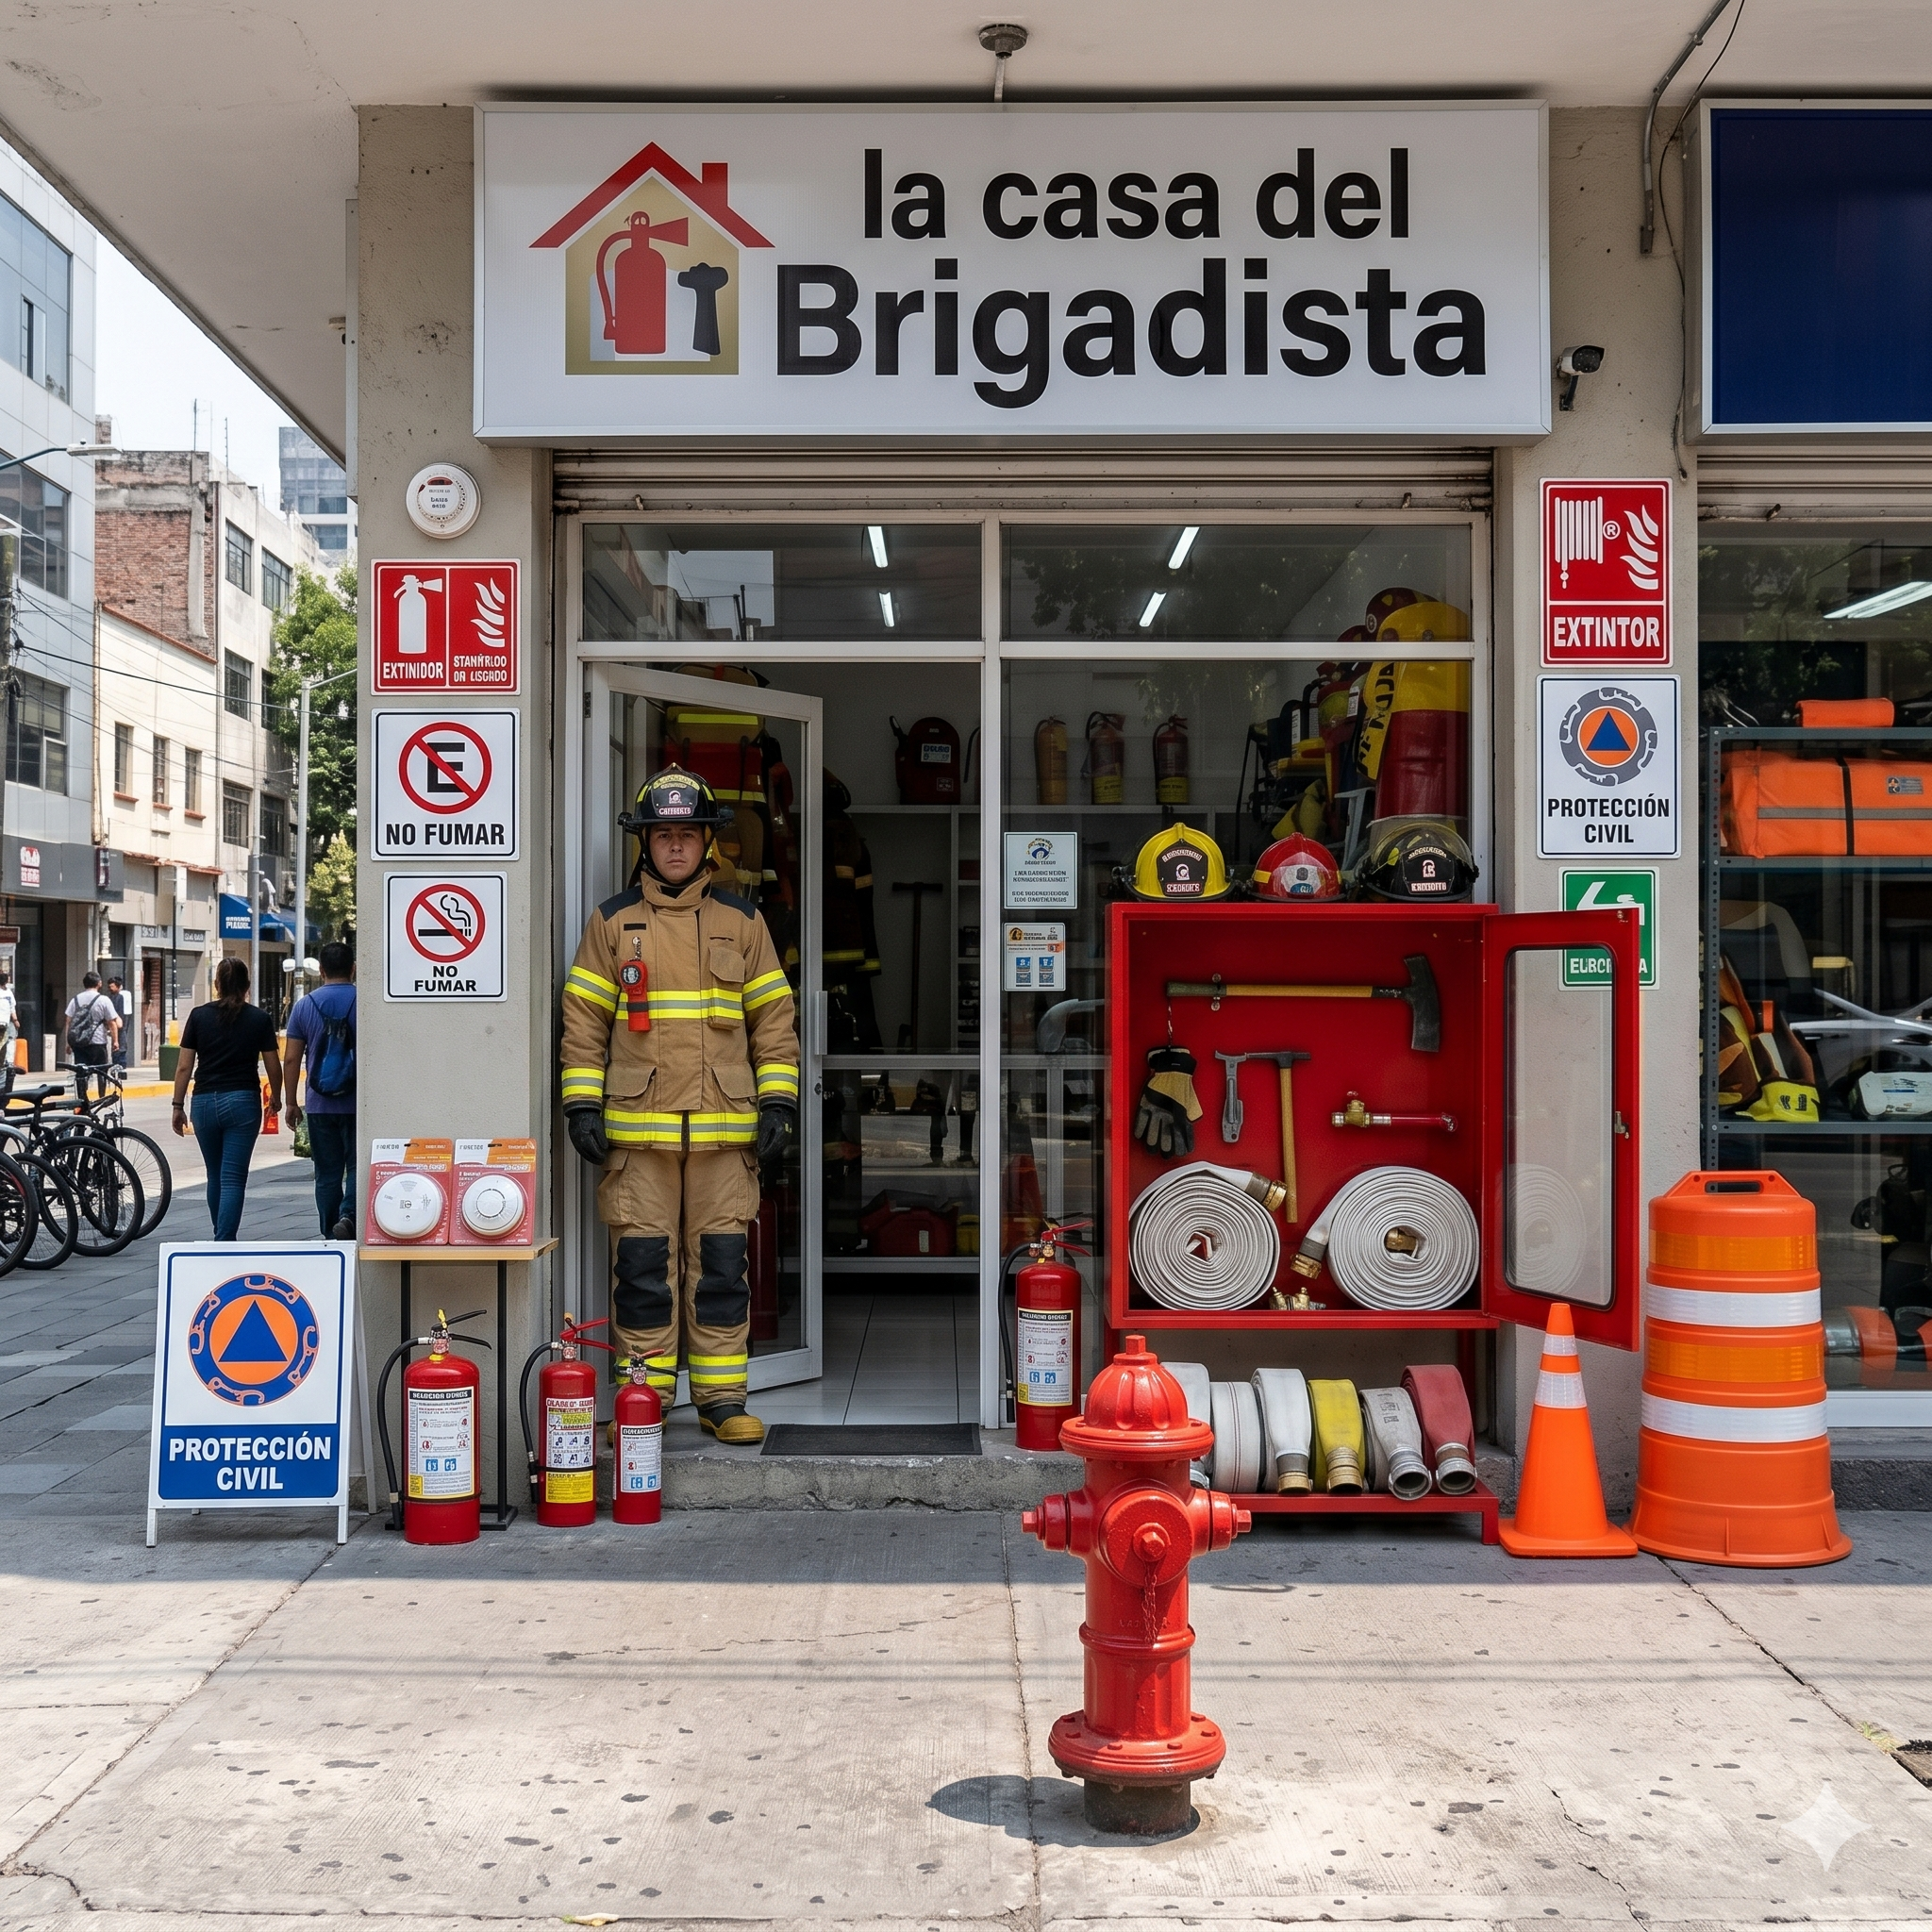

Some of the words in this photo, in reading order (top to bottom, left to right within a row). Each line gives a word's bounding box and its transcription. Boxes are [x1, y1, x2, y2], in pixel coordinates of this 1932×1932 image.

[864, 148, 947, 241] la
[982, 172, 1221, 241] casa
[1256, 147, 1409, 240] del
[776, 257, 1487, 409] Brigadista
[1554, 616, 1660, 648] EXTINTOR
[383, 661, 444, 679] EXTINIDOR
[1547, 792, 1670, 818] PROTECCIÓN
[386, 823, 416, 846] NO
[425, 823, 505, 846] FUMAR
[1584, 824, 1635, 843] CIVIL
[432, 965, 458, 978] NO
[414, 979, 477, 992] FUMAR
[169, 1430, 331, 1461] PROTECCIÓN
[216, 1466, 284, 1491] CIVIL
